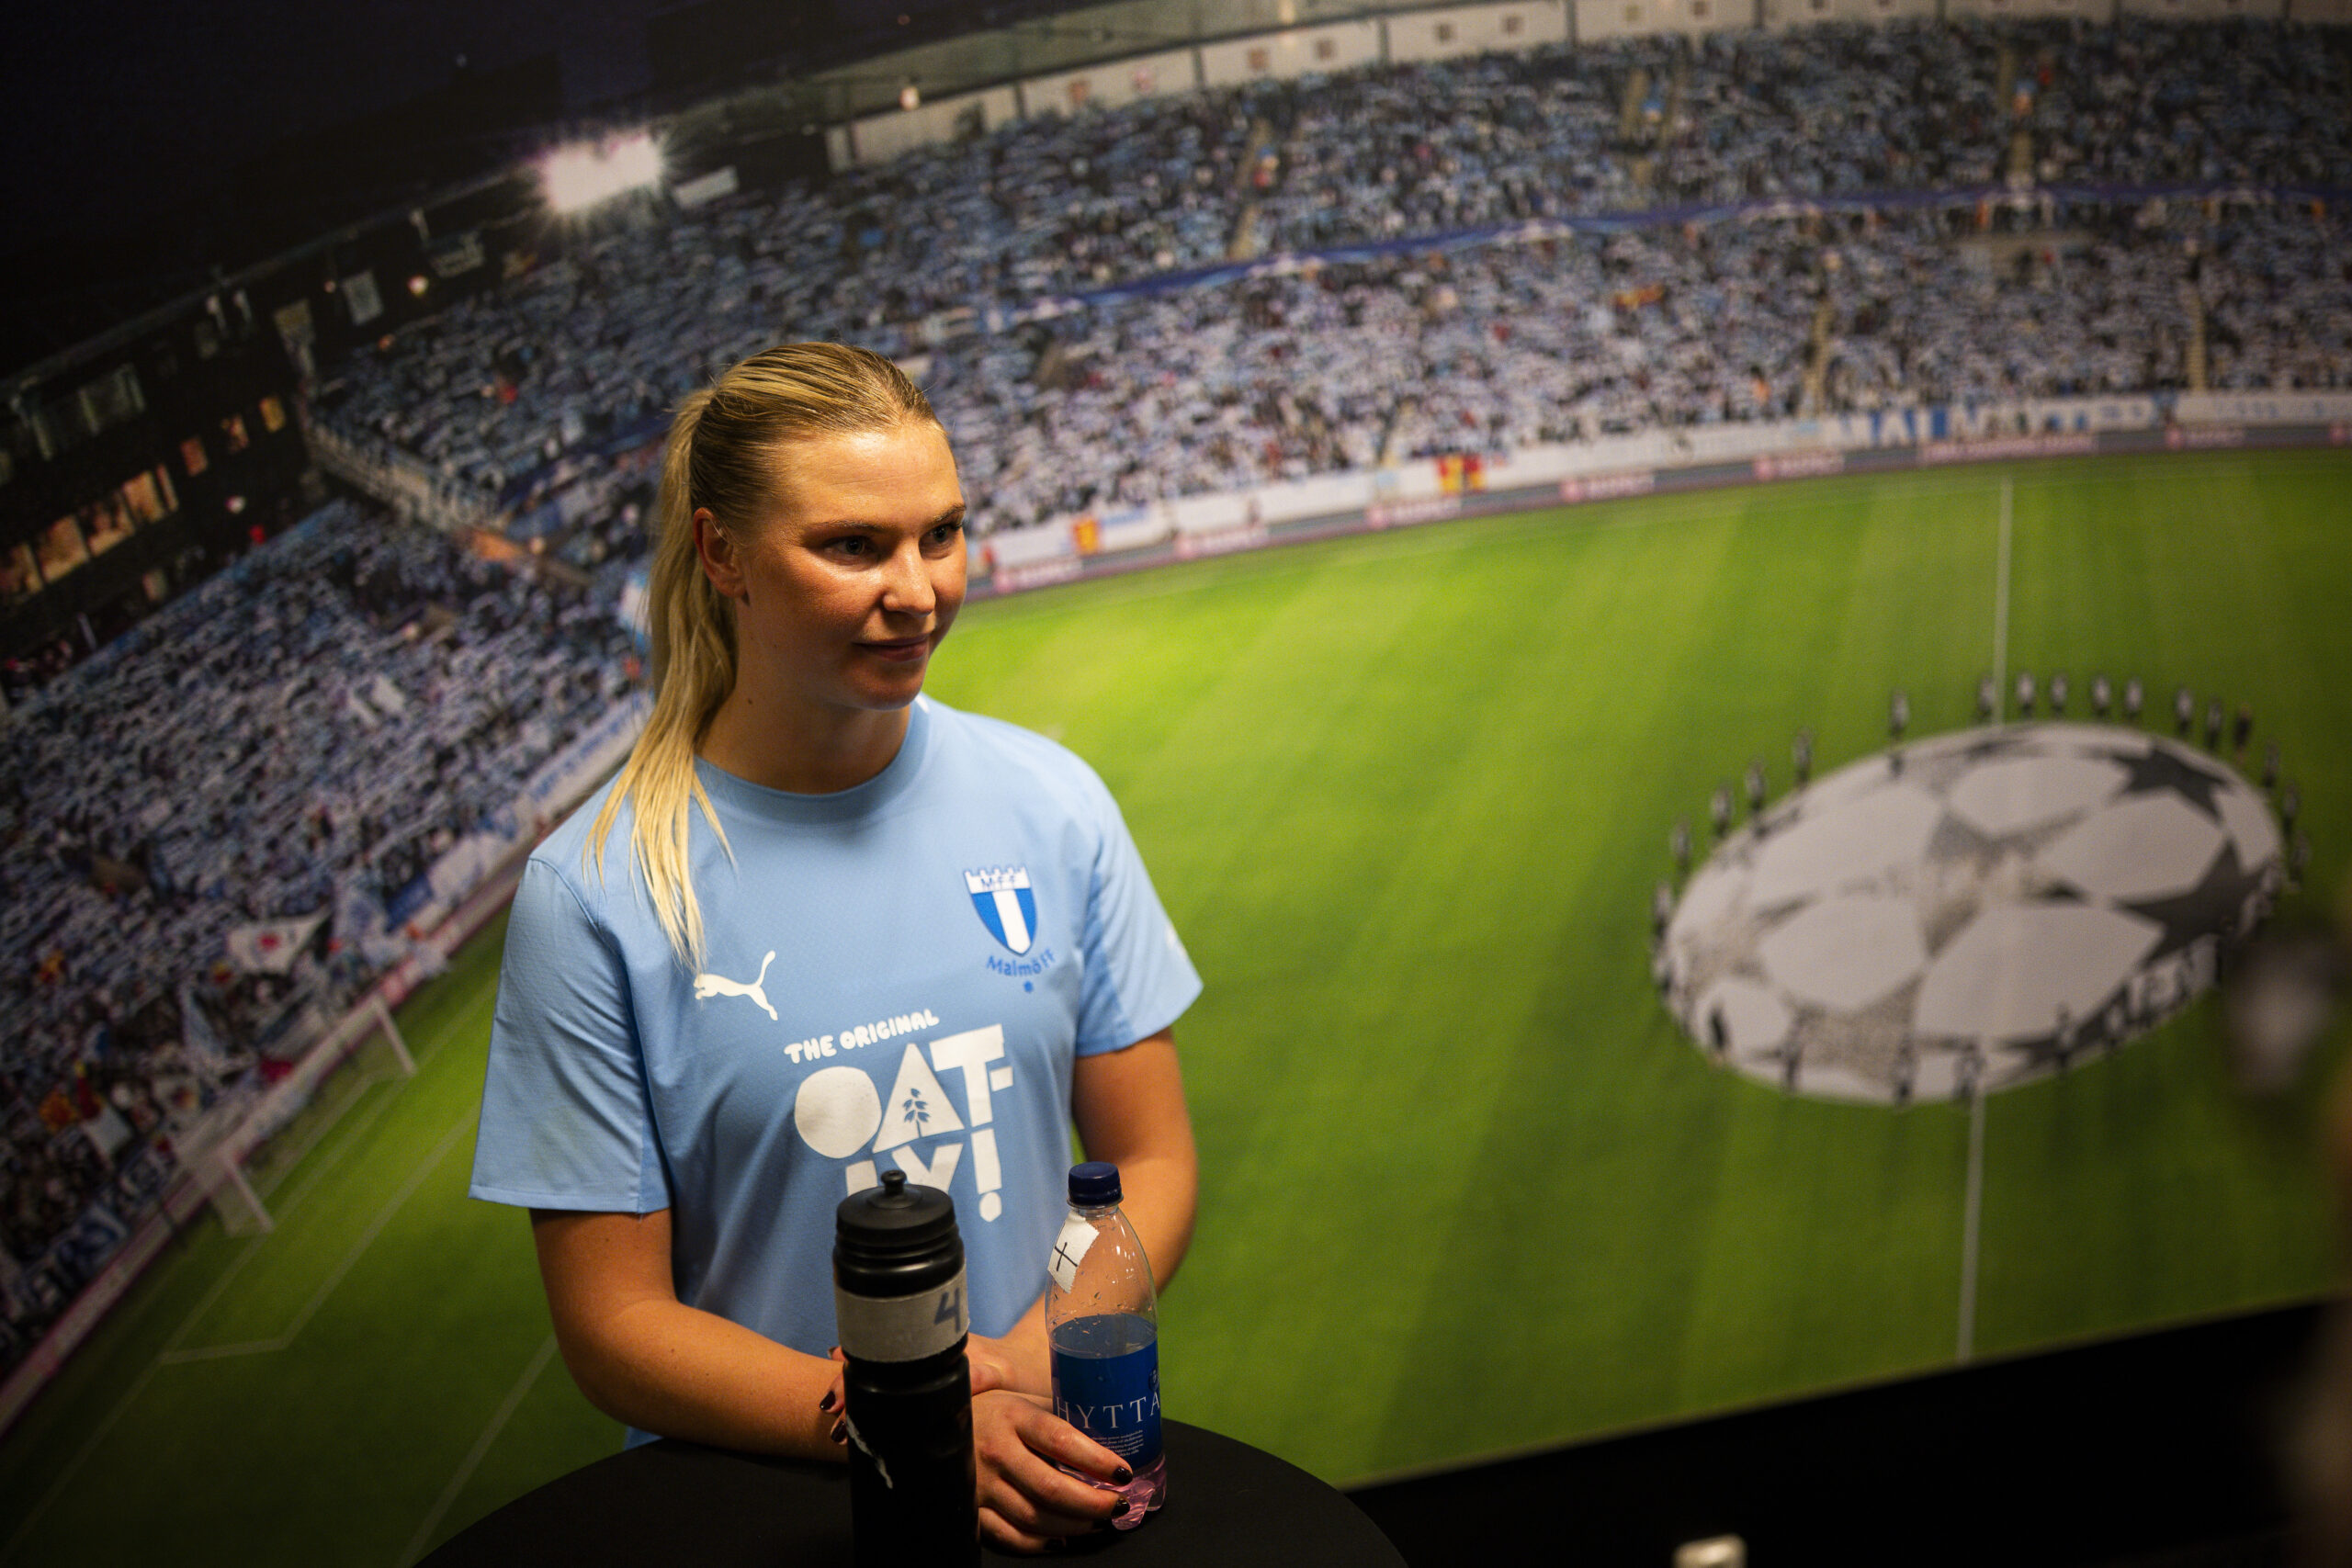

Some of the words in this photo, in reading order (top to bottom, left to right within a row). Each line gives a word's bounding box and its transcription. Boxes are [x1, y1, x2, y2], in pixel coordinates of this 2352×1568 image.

[986, 954, 1042, 976] Malmö
[784, 1035, 837, 1064] THE
[840, 1009, 940, 1050] ORIGINAL
[933, 1287, 961, 1333] 4
[1057, 1391, 1160, 1428] HYTTA
